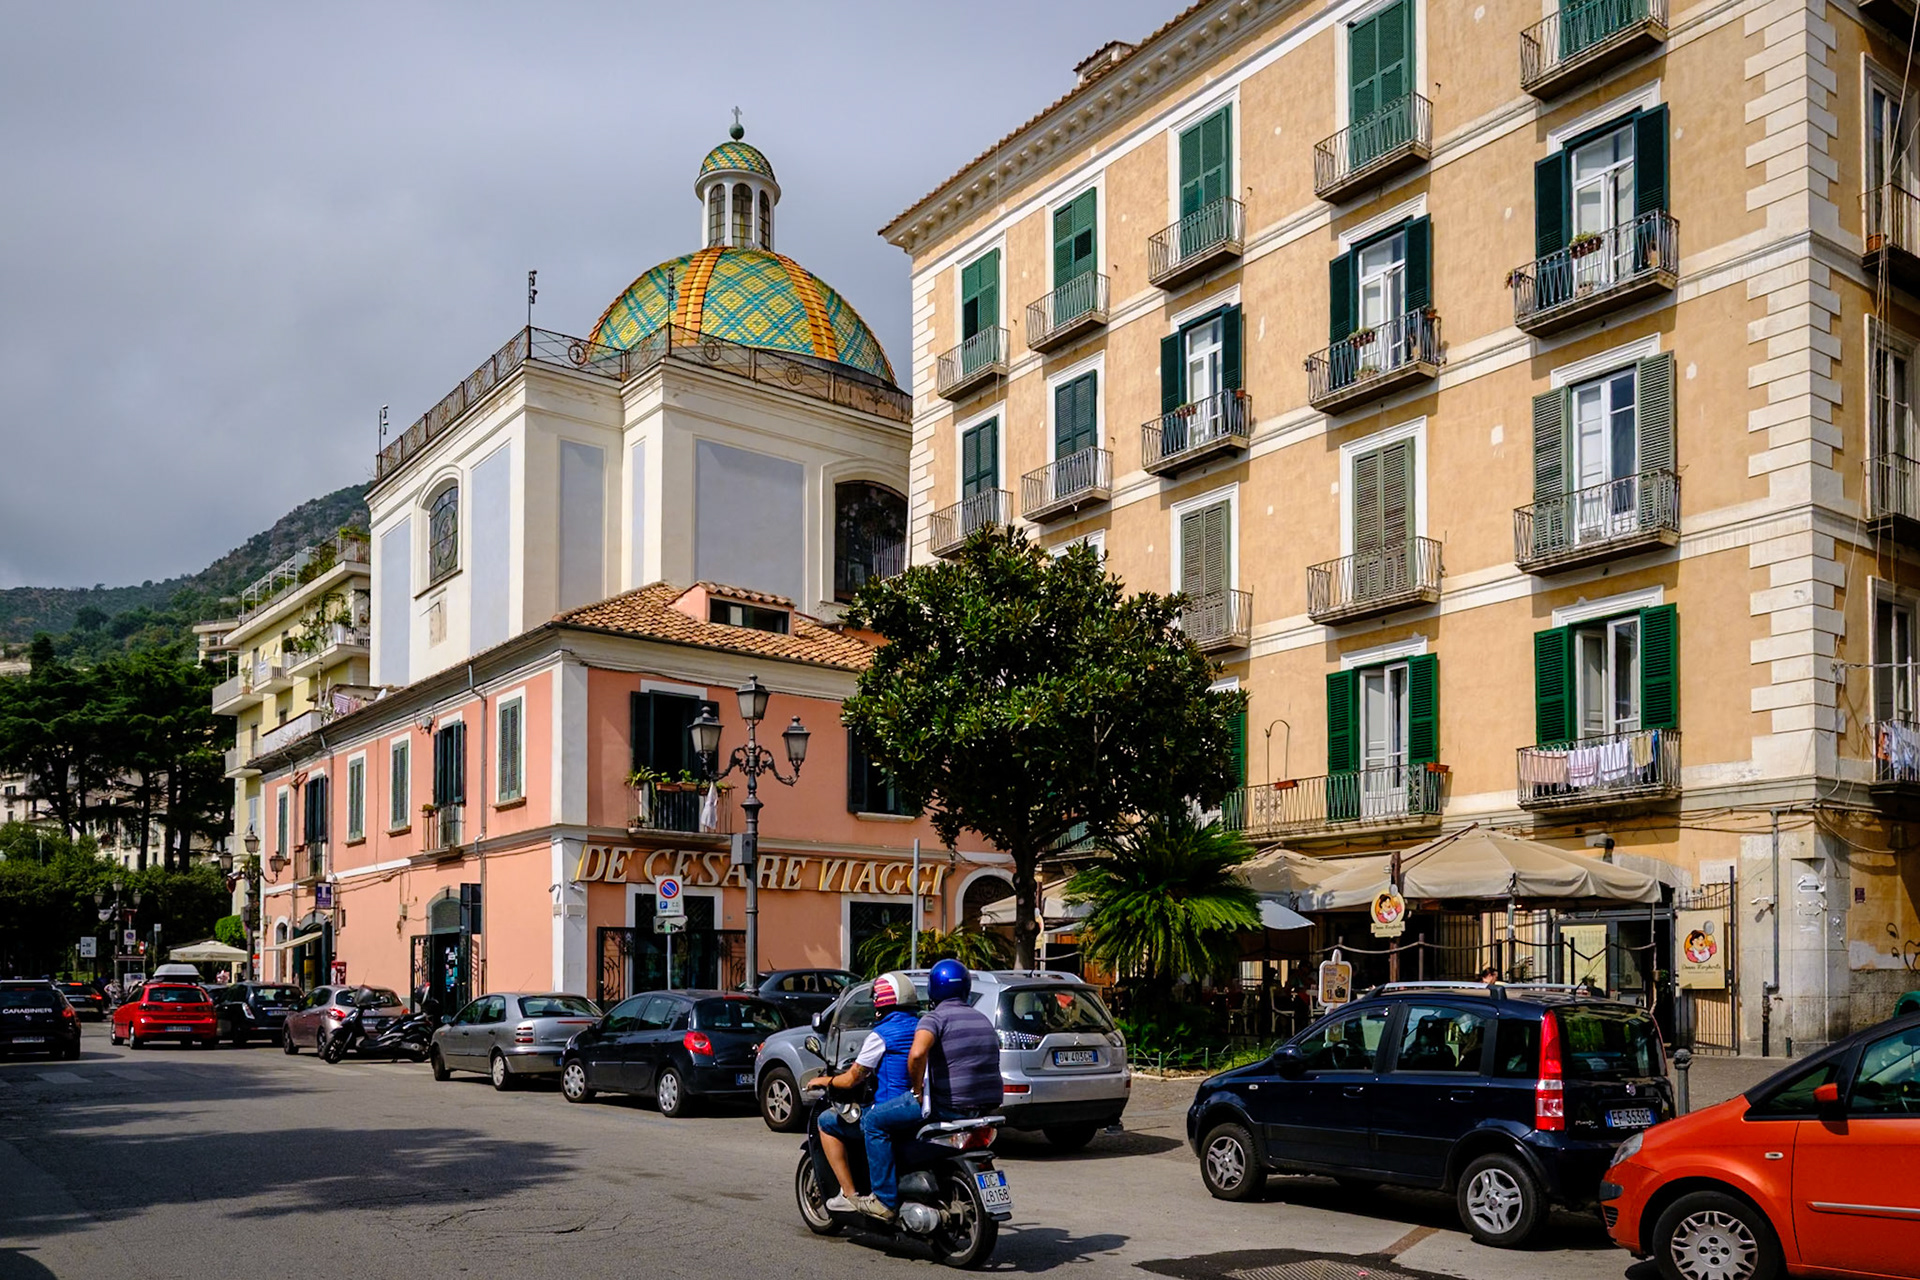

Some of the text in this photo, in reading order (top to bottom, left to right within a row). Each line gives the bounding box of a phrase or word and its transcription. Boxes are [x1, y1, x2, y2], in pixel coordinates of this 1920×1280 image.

[575, 844, 947, 896] DE CESARE VIAGGI
[985, 1188, 1009, 1203] 48168
